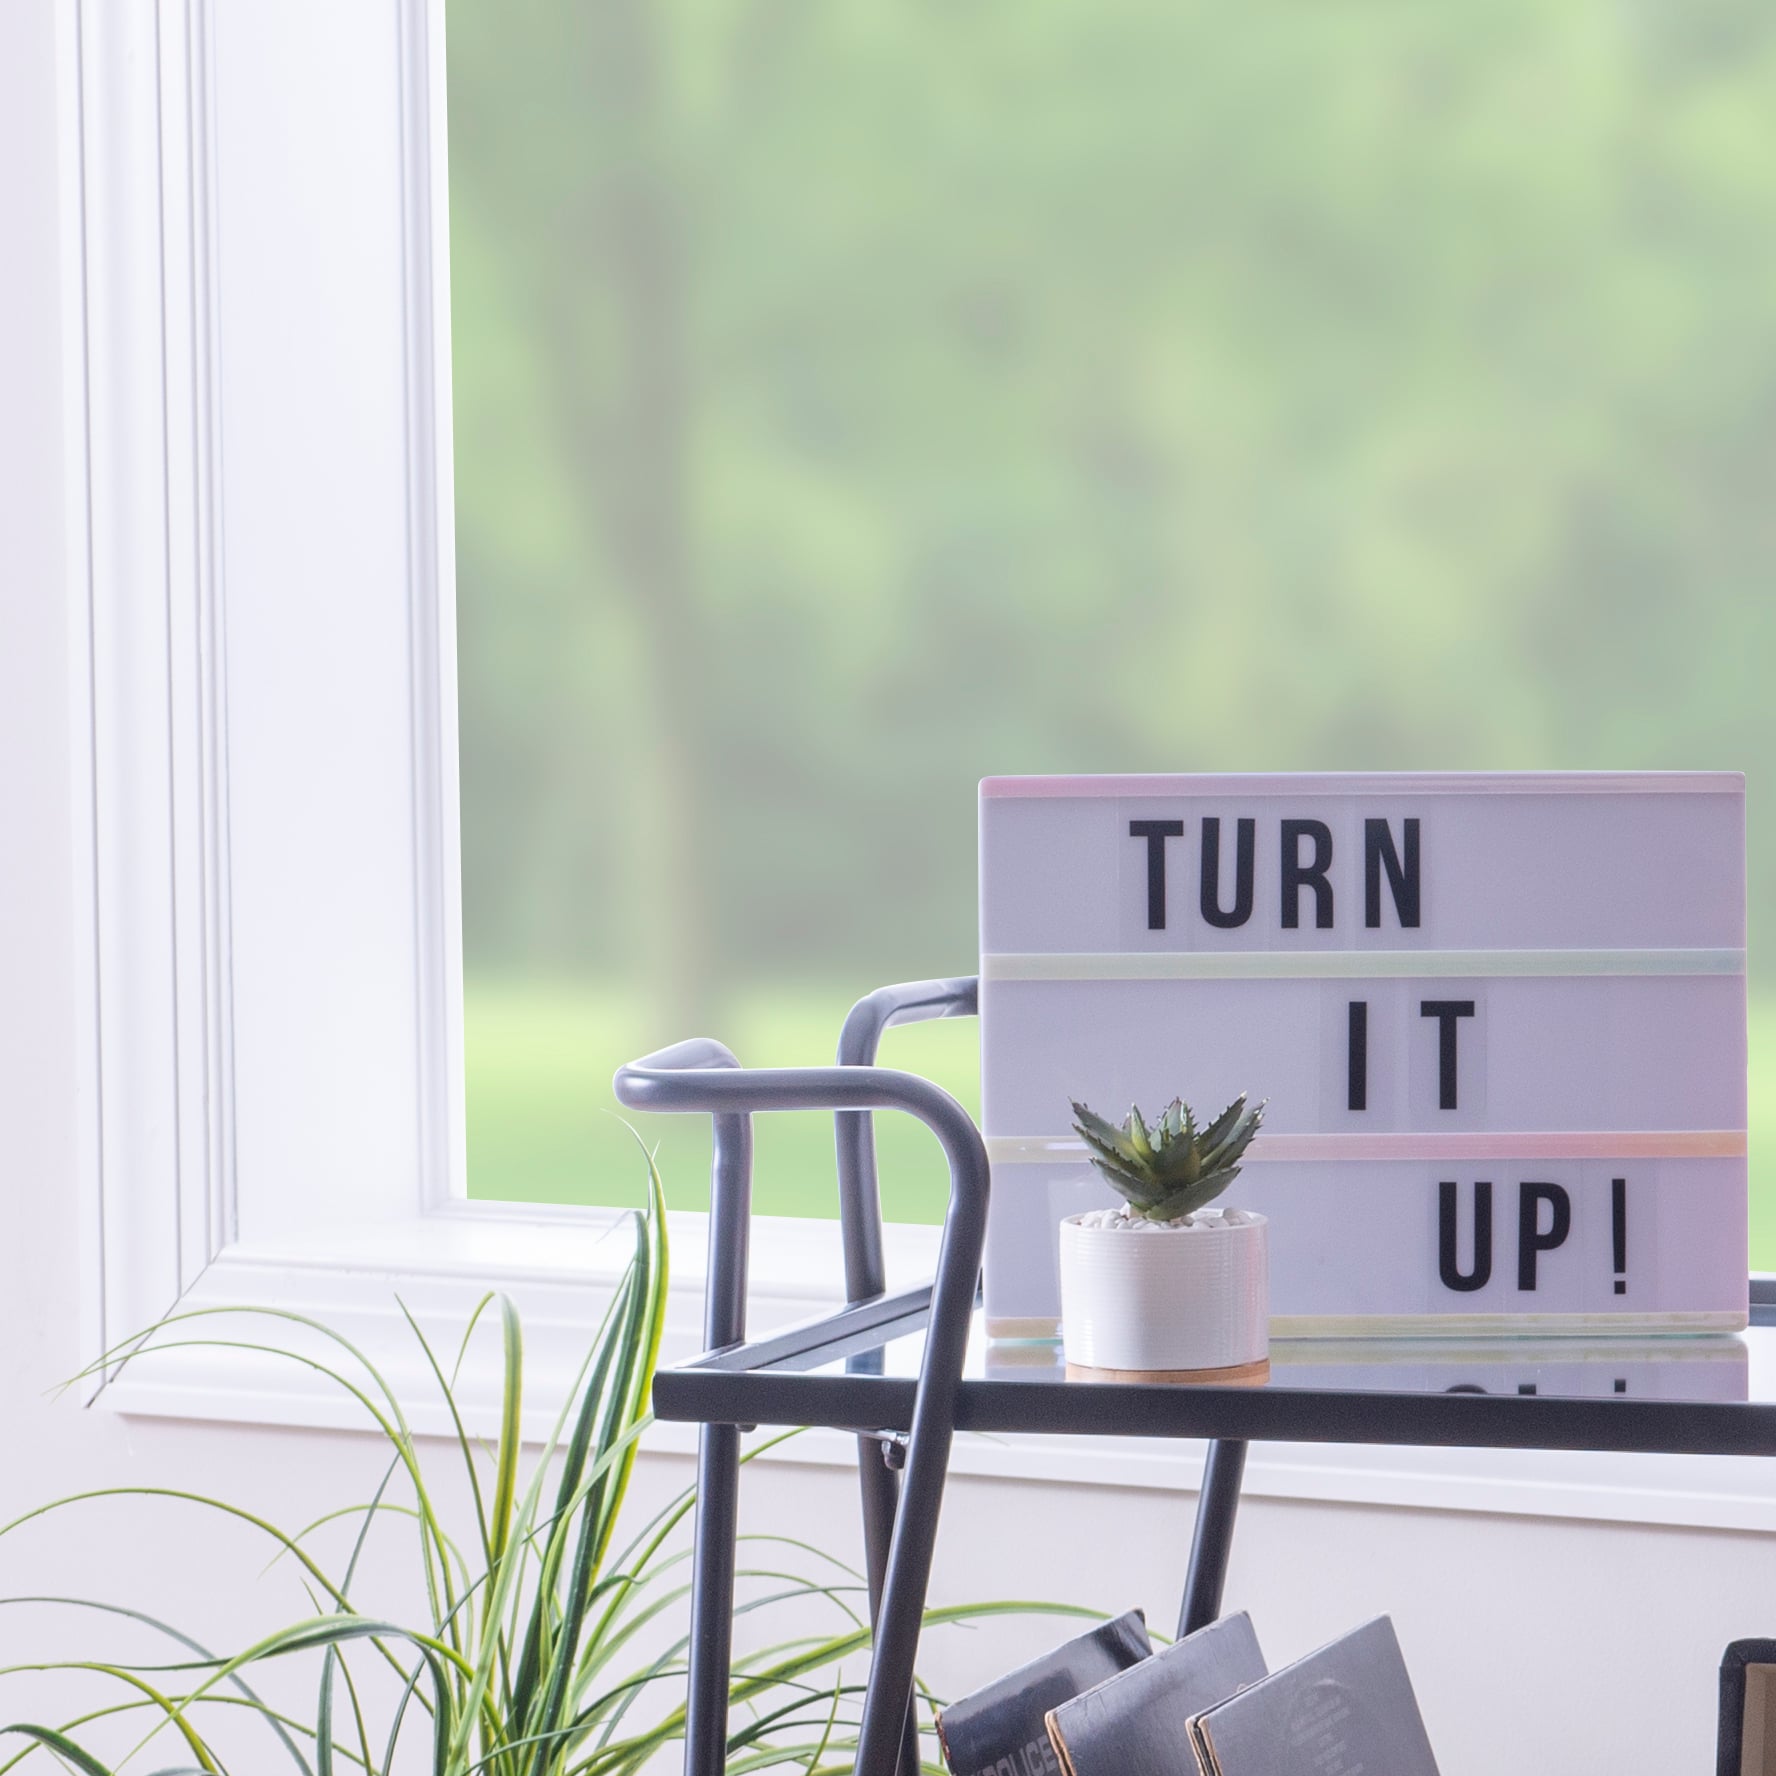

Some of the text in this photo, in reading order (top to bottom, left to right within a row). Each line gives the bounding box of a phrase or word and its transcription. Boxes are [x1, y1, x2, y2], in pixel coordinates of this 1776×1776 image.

[1129, 817, 1422, 931] TURN
[1347, 1000, 1476, 1112] IT
[1438, 1178, 1628, 1296] UP!
